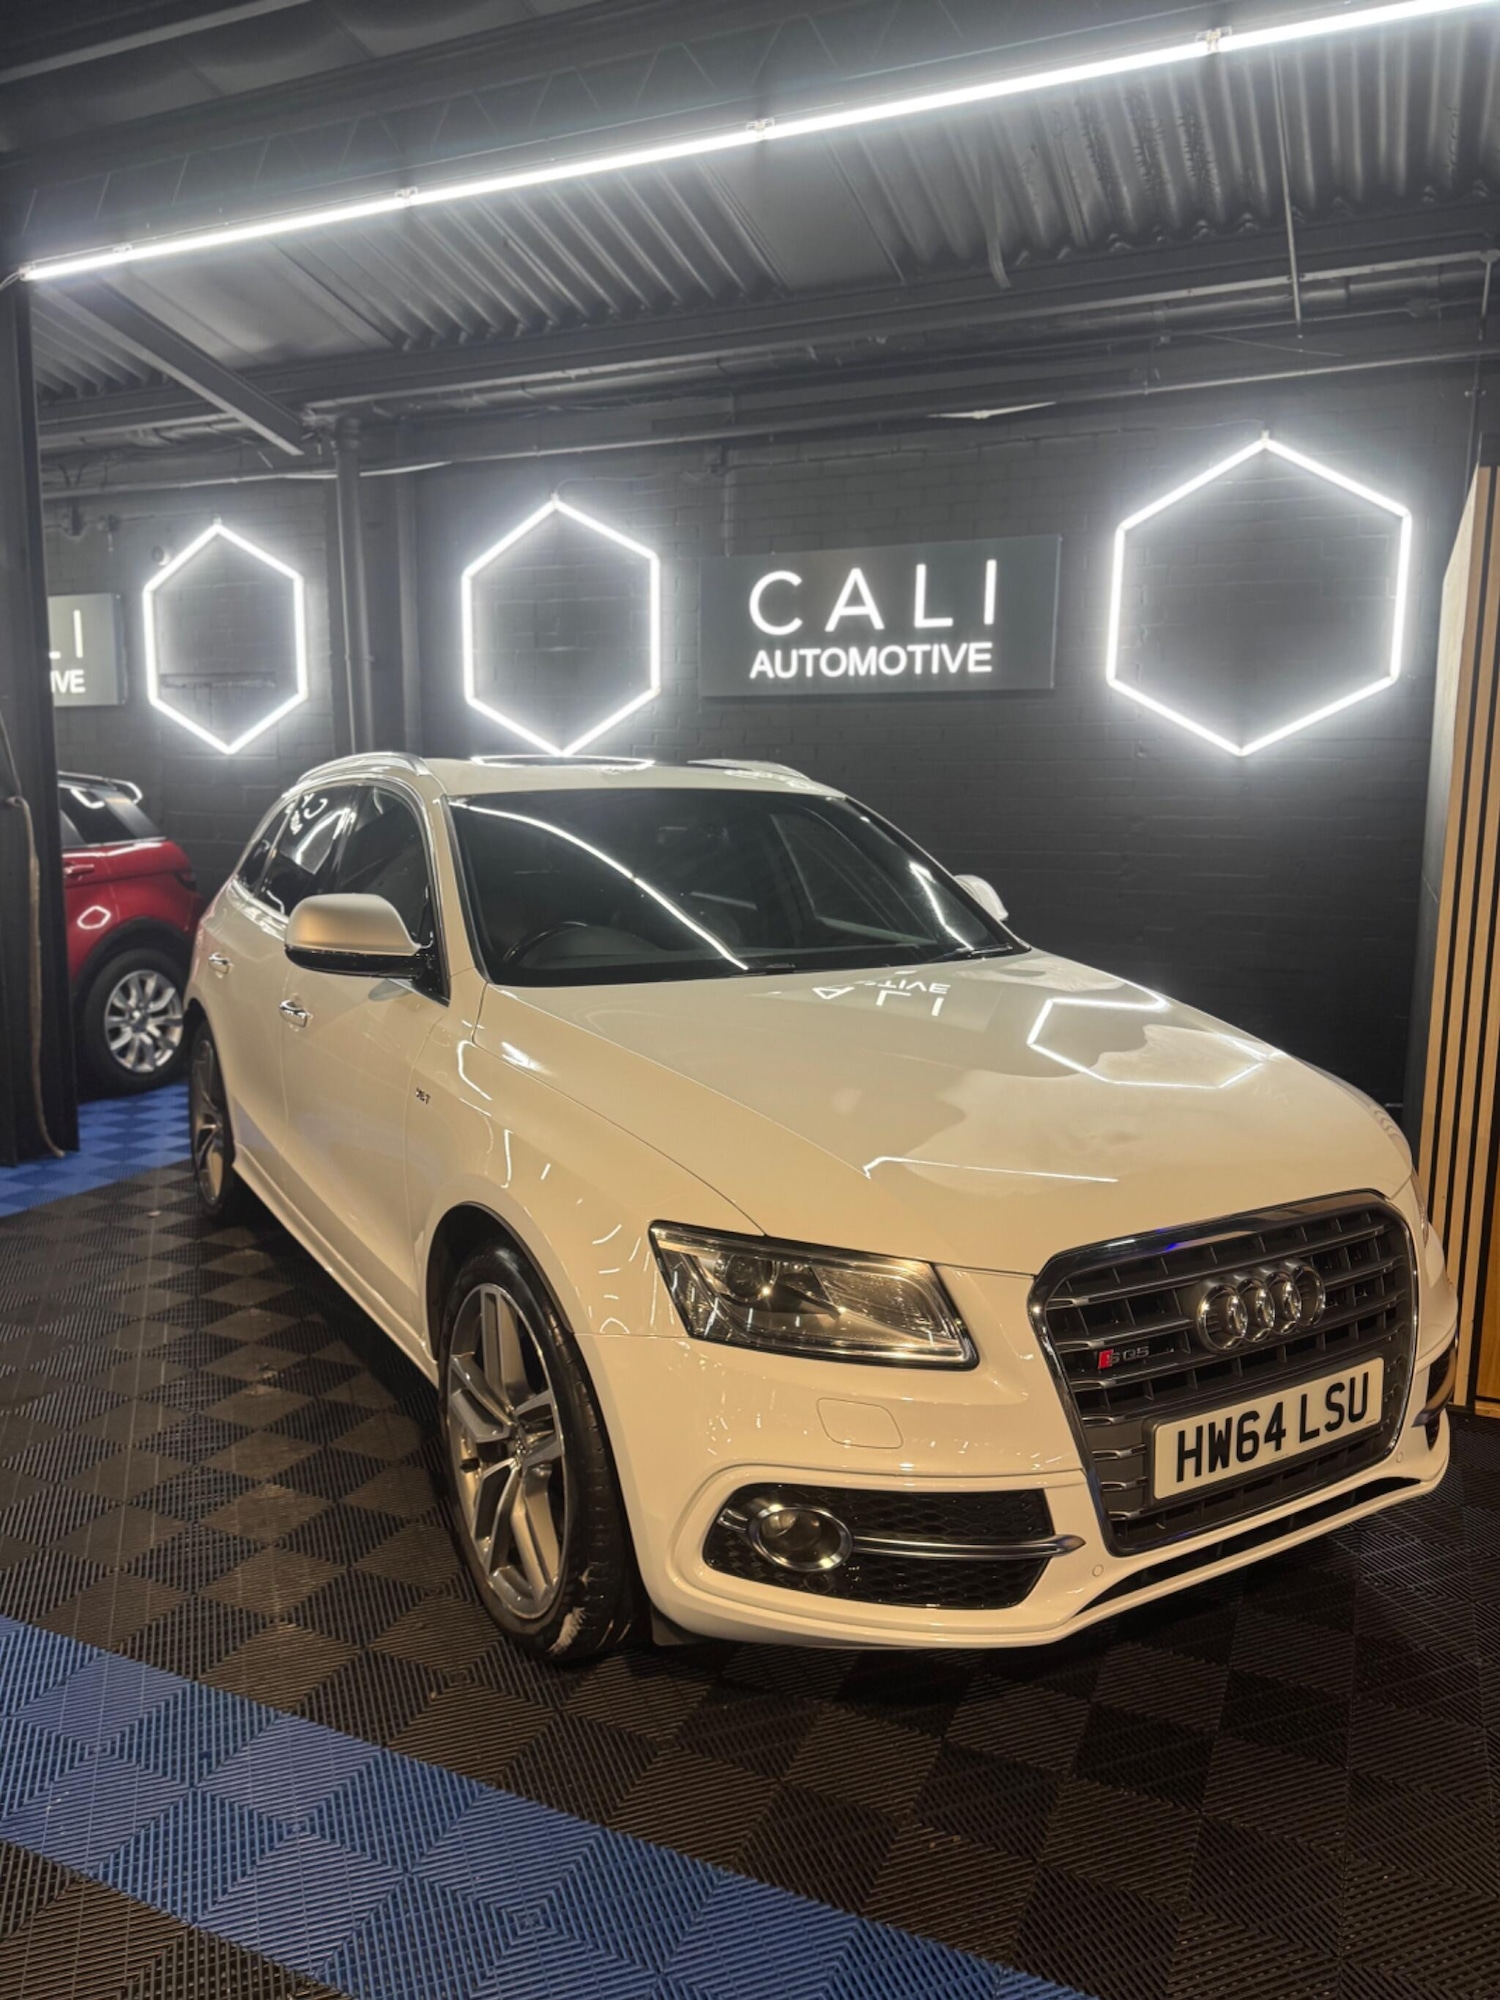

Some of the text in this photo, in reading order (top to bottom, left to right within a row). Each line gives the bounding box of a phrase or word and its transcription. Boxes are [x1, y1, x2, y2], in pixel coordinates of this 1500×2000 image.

[749, 559, 997, 635] CALI
[749, 642, 993, 679] AUTOMOTIVE
[1176, 1371, 1369, 1483] HW64 LSU
